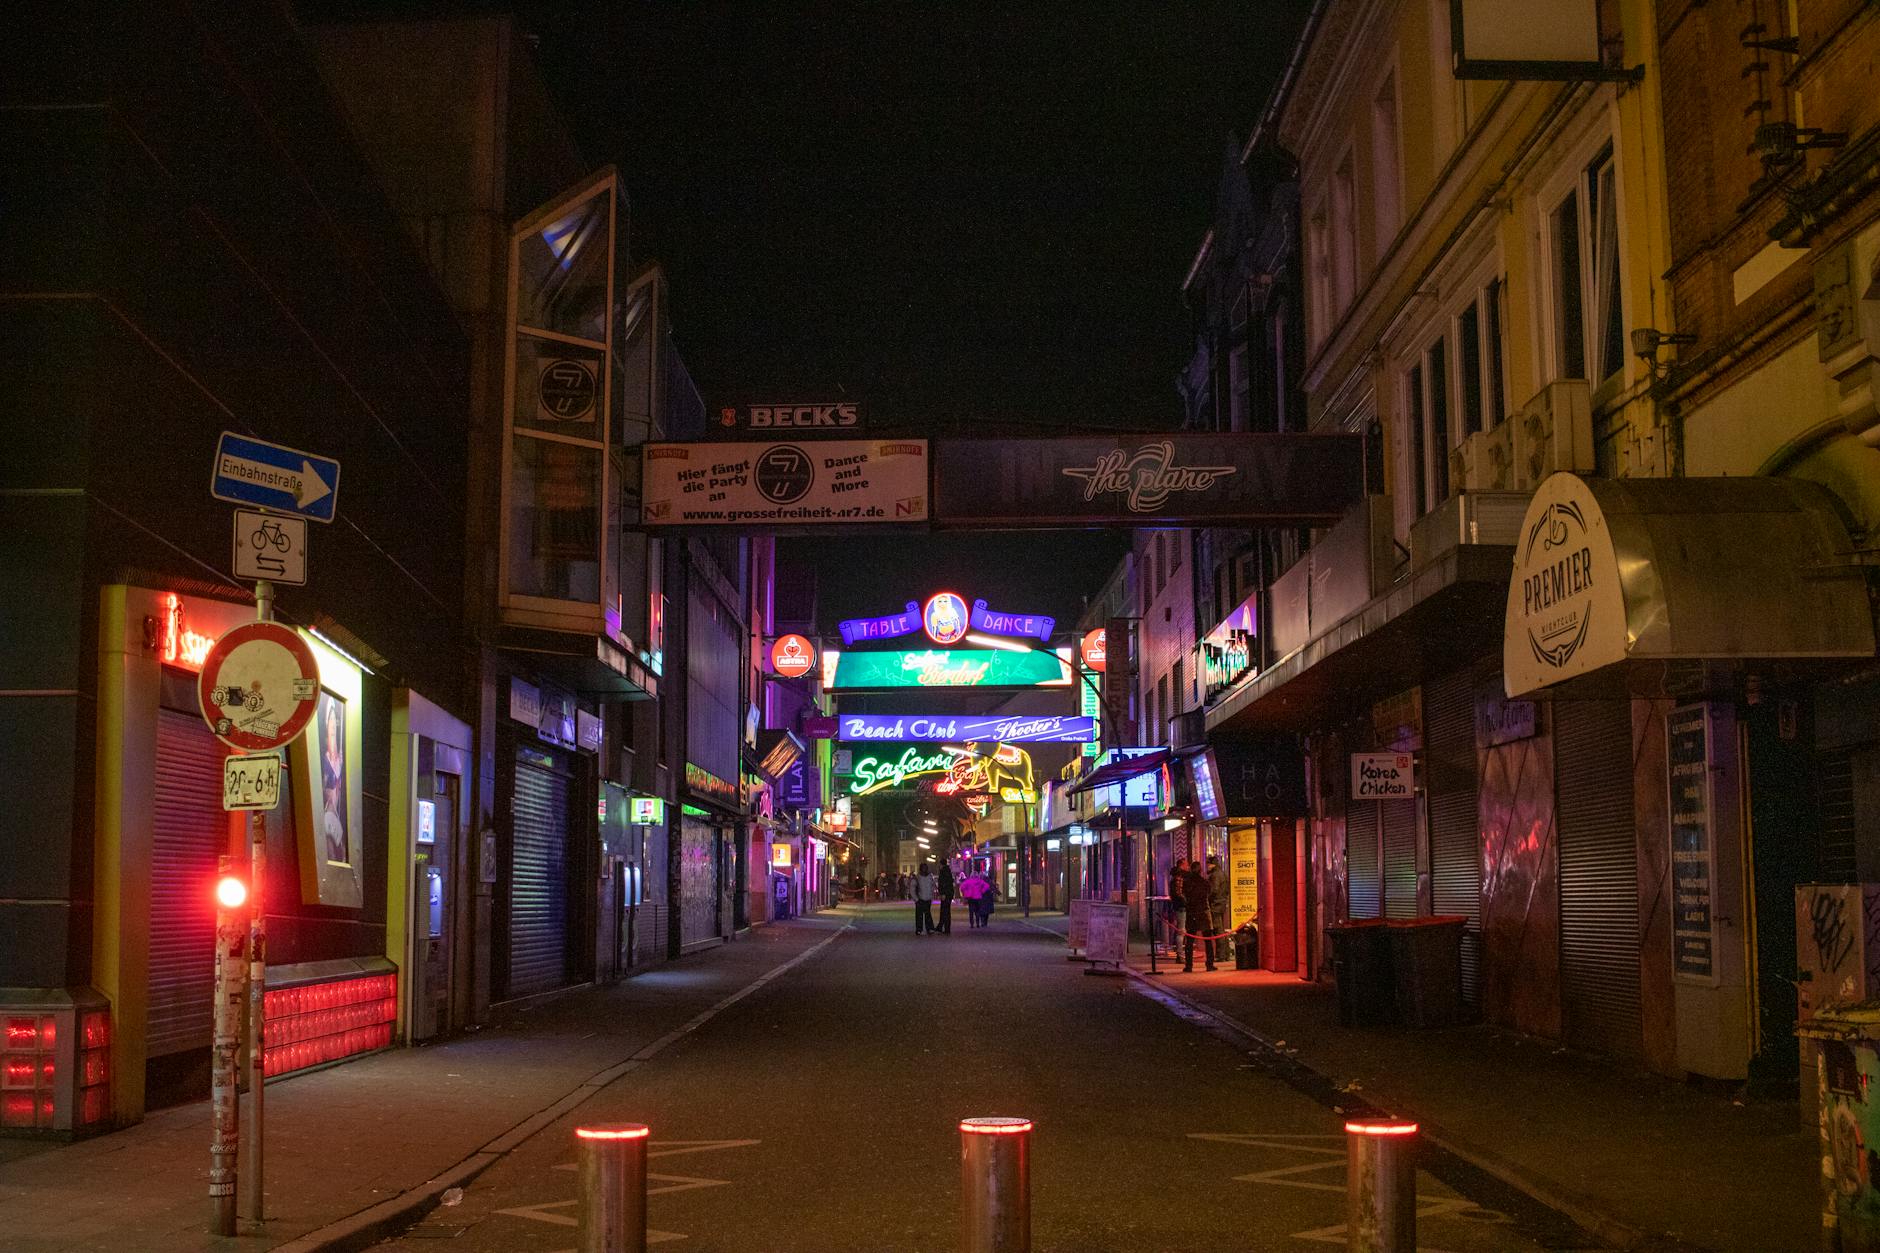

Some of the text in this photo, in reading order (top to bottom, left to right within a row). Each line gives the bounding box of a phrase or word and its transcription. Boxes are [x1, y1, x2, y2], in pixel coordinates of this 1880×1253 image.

[750, 403, 857, 427] BECK'S
[677, 460, 751, 481] Hier fängt
[824, 454, 868, 469] Dance
[221, 459, 304, 490] Einbahnstraße
[835, 465, 861, 480] and
[1084, 440, 1216, 513] the plane
[682, 482, 705, 493] die
[709, 474, 748, 488] Party
[831, 480, 869, 494] More
[709, 492, 726, 502] an
[683, 506, 884, 521] www.grossefreiheit-nr7.de
[1524, 547, 1594, 617] PREMIER
[861, 613, 1034, 637] TABLE DANCE
[1542, 611, 1578, 634] NIGHTCLUB
[846, 719, 957, 738] Beach Club
[993, 718, 1060, 740] Shooter's
[851, 747, 958, 793] Safari
[1360, 761, 1401, 780] Korea
[1359, 779, 1406, 795] Chicken
